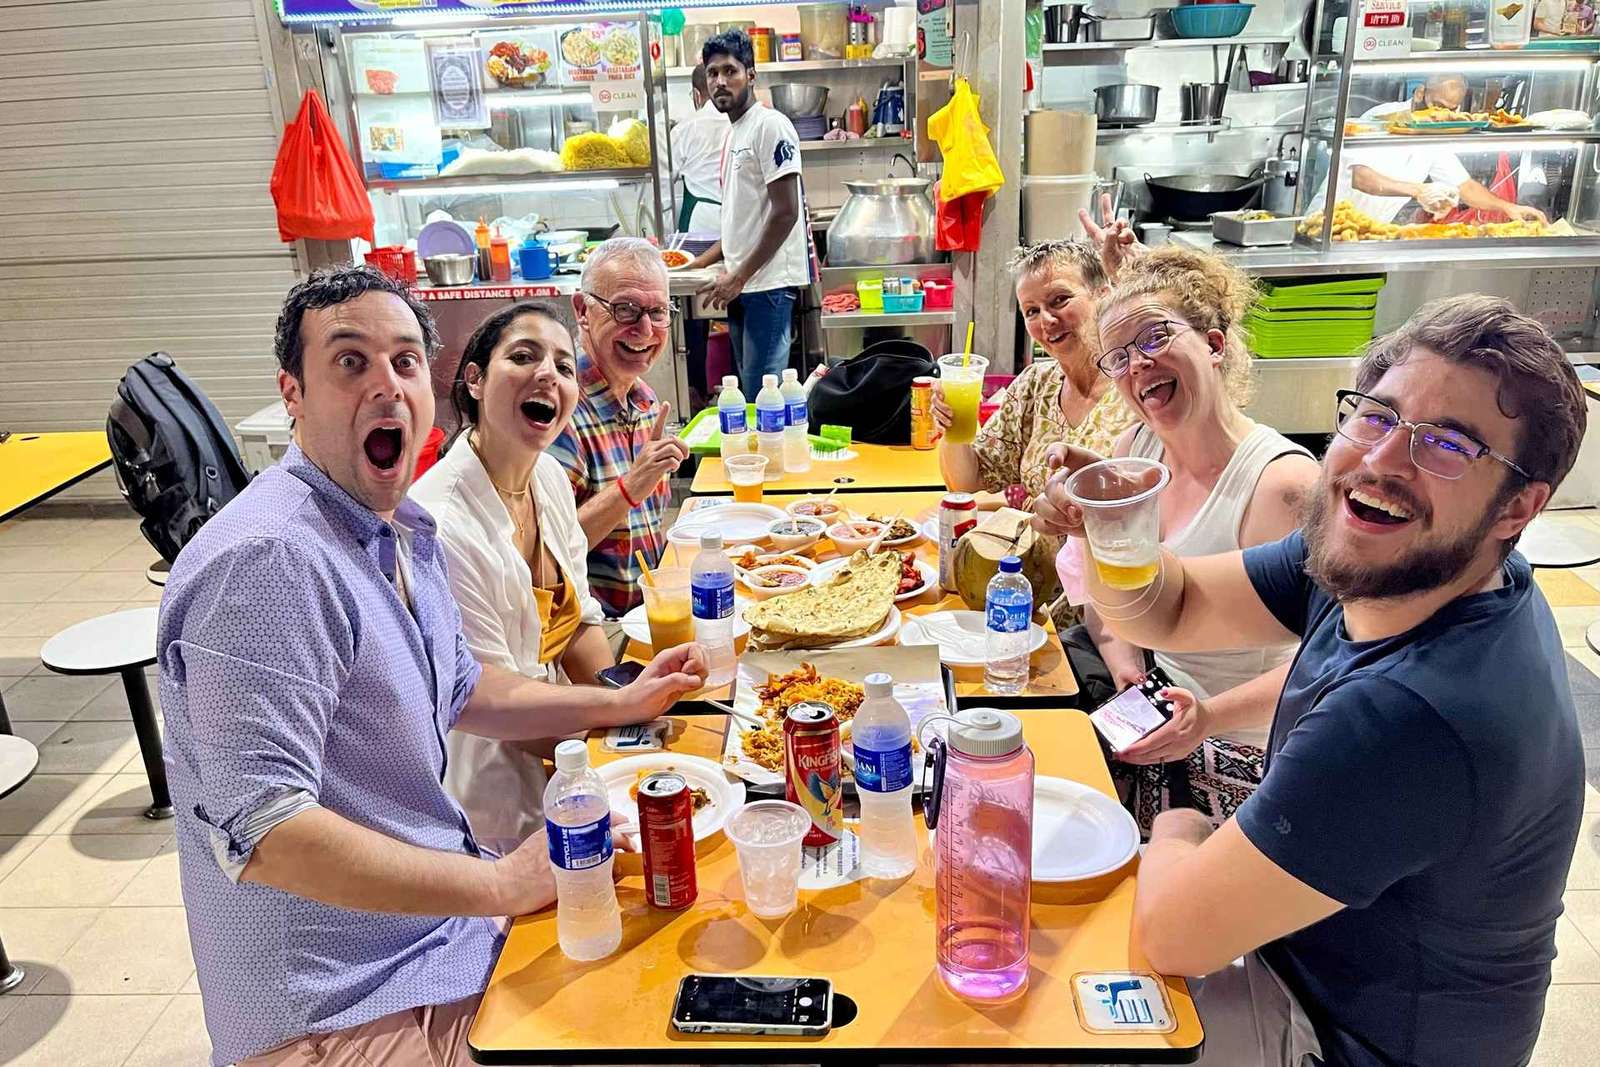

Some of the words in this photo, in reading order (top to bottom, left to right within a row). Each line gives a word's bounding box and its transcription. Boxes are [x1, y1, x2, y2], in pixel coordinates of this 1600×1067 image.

[613, 92, 637, 100] CLEAN
[437, 291, 462, 299] SAFE
[464, 289, 512, 298] DISTANCE
[528, 289, 550, 297] 1.0M
[561, 828, 569, 840] ME
[563, 840, 571, 869] RECYCLE
